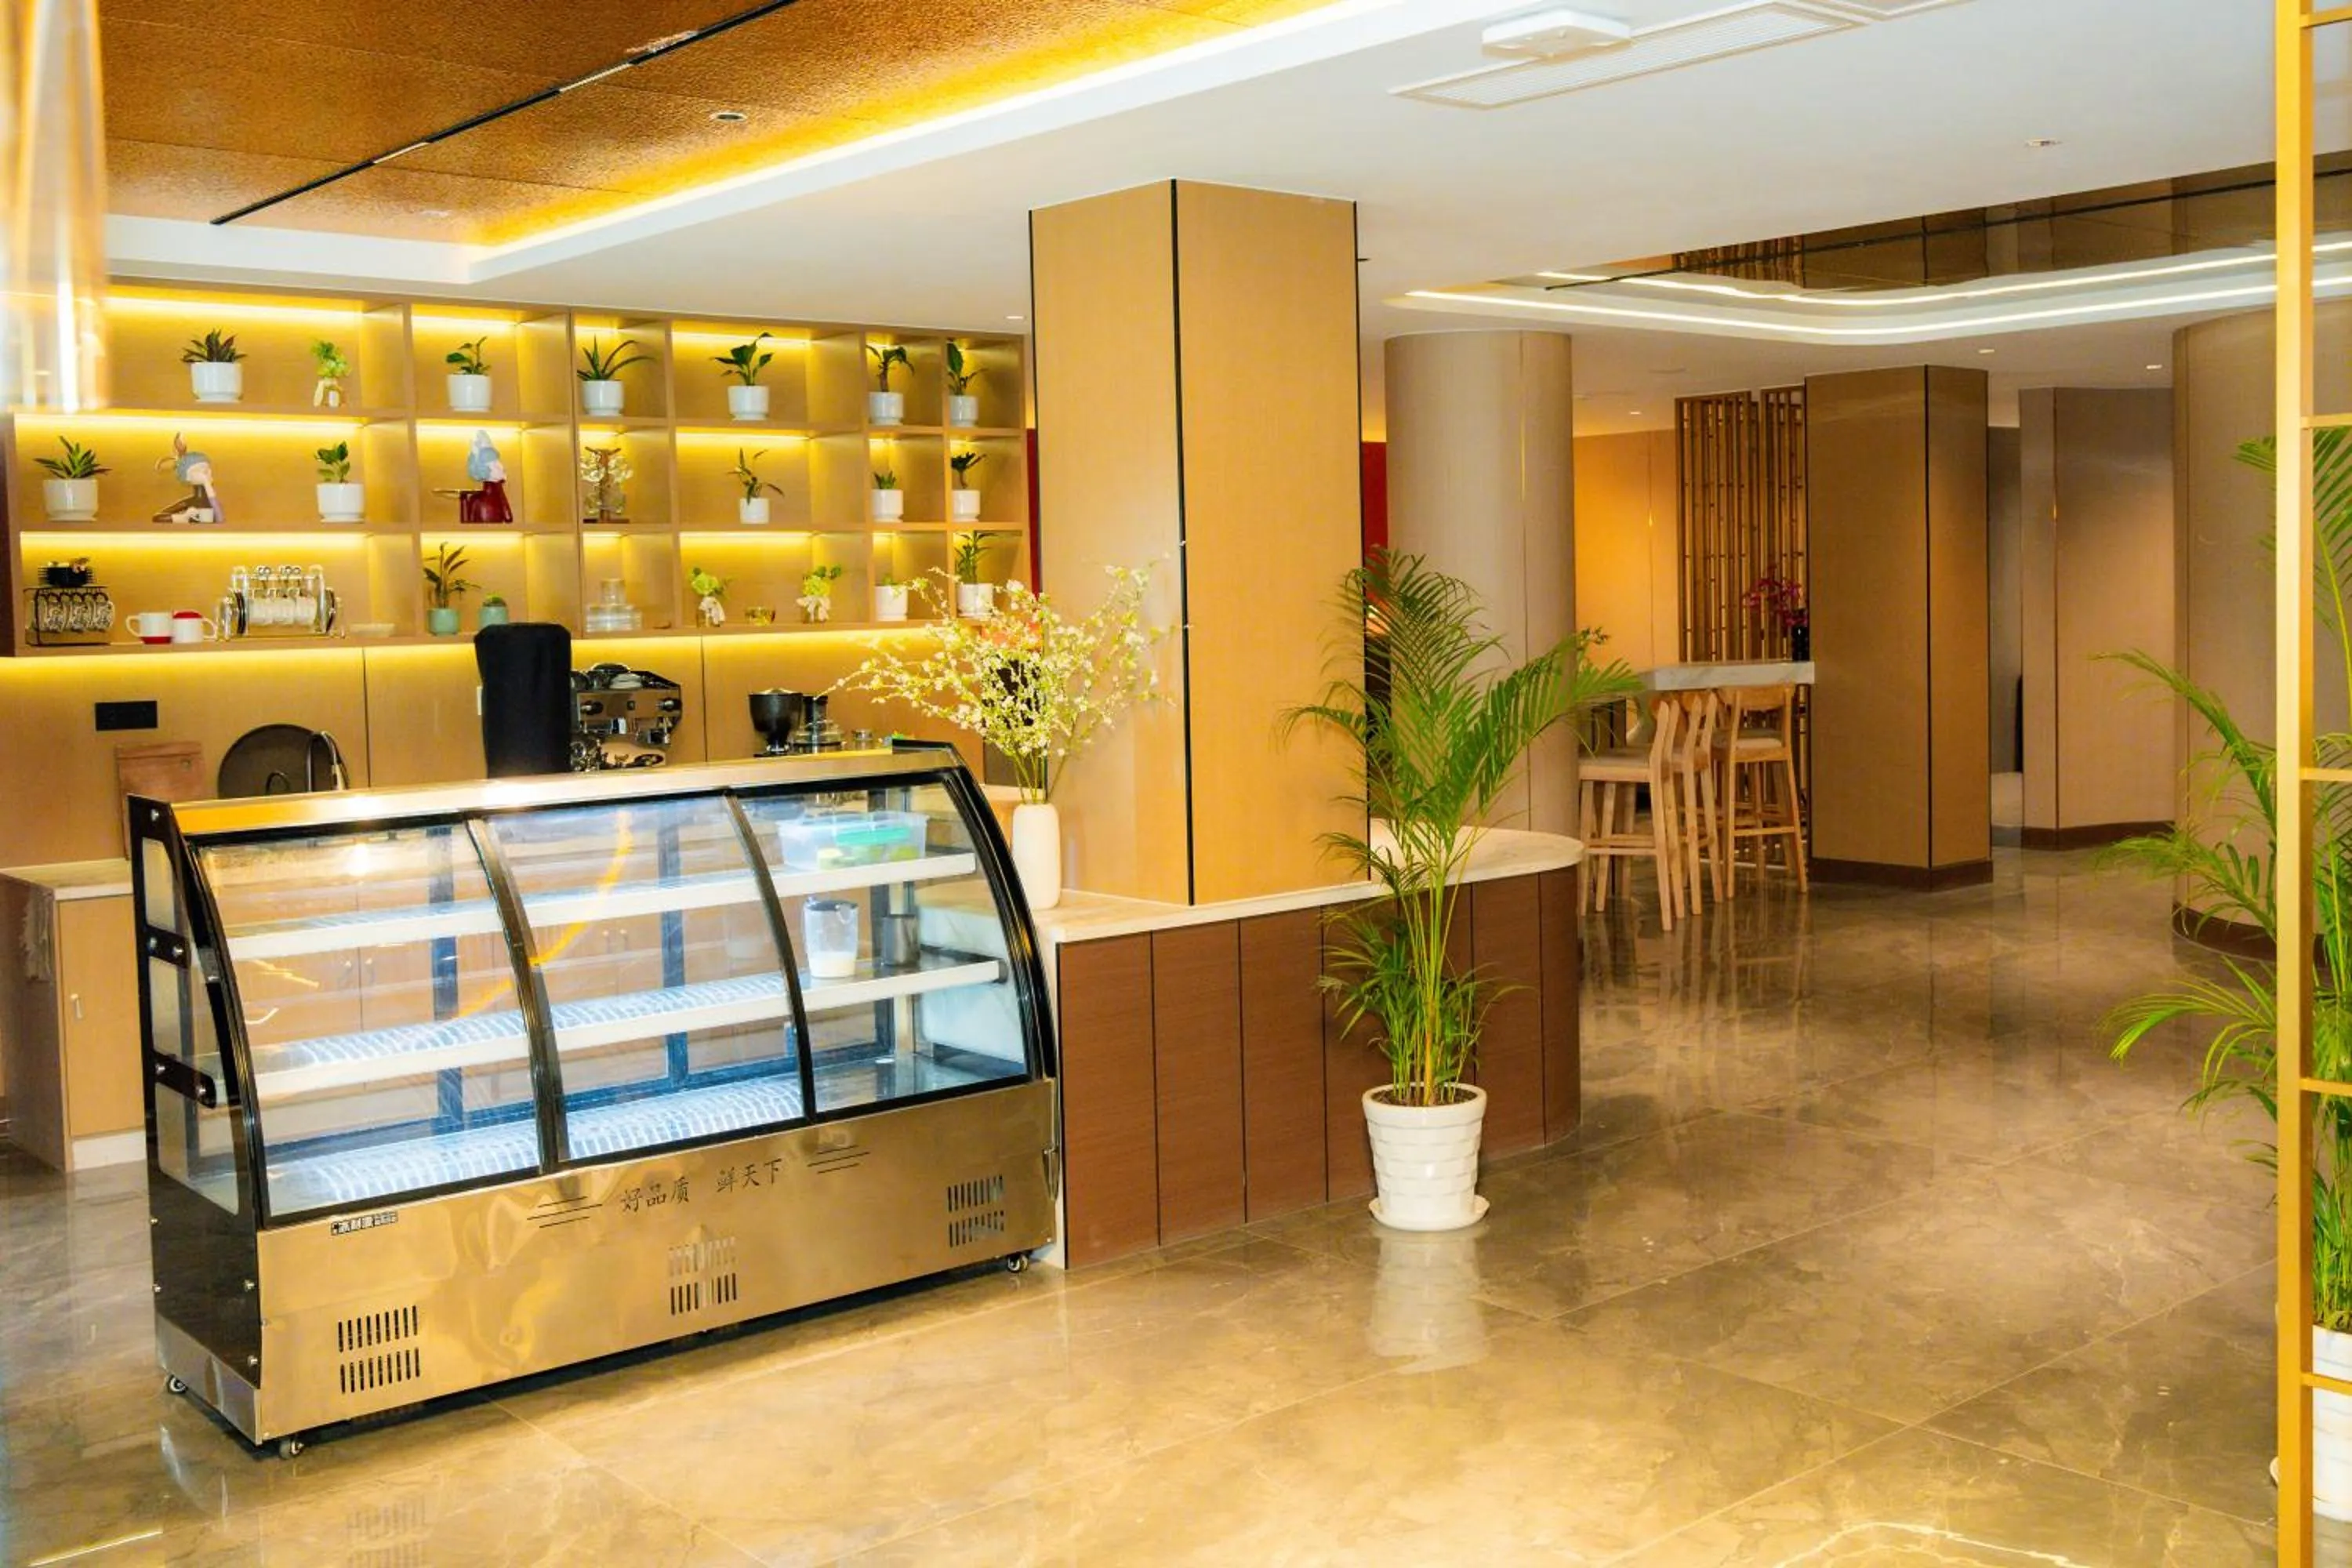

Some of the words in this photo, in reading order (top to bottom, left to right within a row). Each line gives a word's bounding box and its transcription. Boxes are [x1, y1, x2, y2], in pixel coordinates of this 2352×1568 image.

[621, 1176, 689, 1212] 好品质
[717, 1158, 782, 1192] 鲜天下
